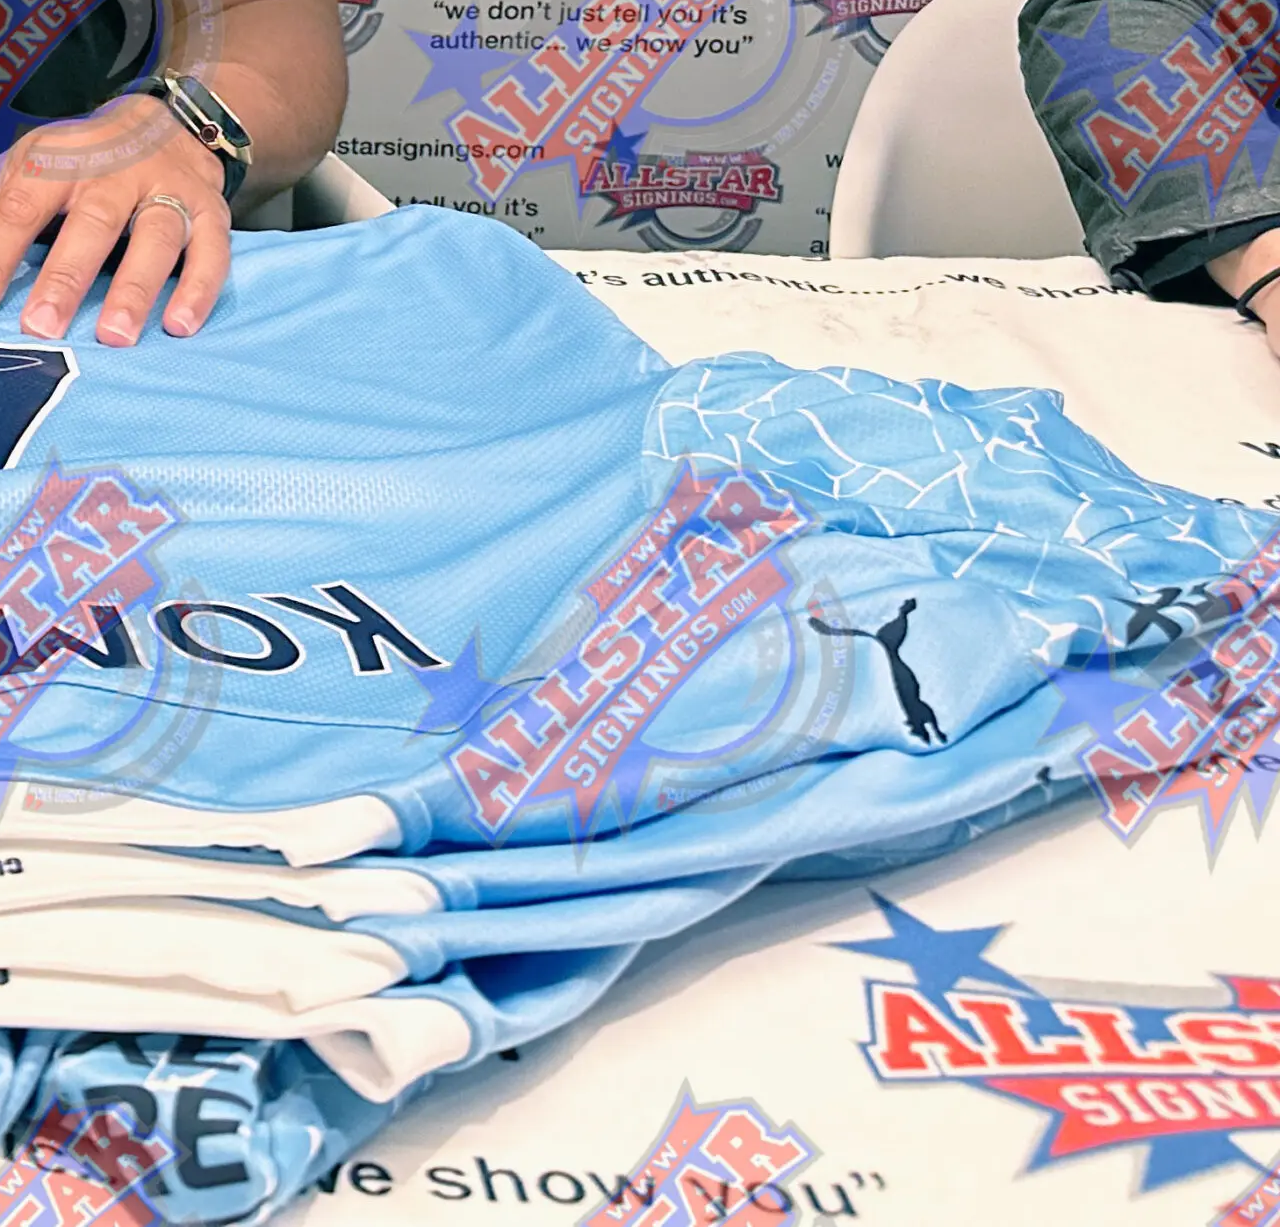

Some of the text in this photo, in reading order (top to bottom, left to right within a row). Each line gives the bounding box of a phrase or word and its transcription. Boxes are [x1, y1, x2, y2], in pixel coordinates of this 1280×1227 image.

[588, 161, 779, 199] ALLSTAR
[868, 982, 1280, 1077] ALLS
[426, 1156, 658, 1209] show
